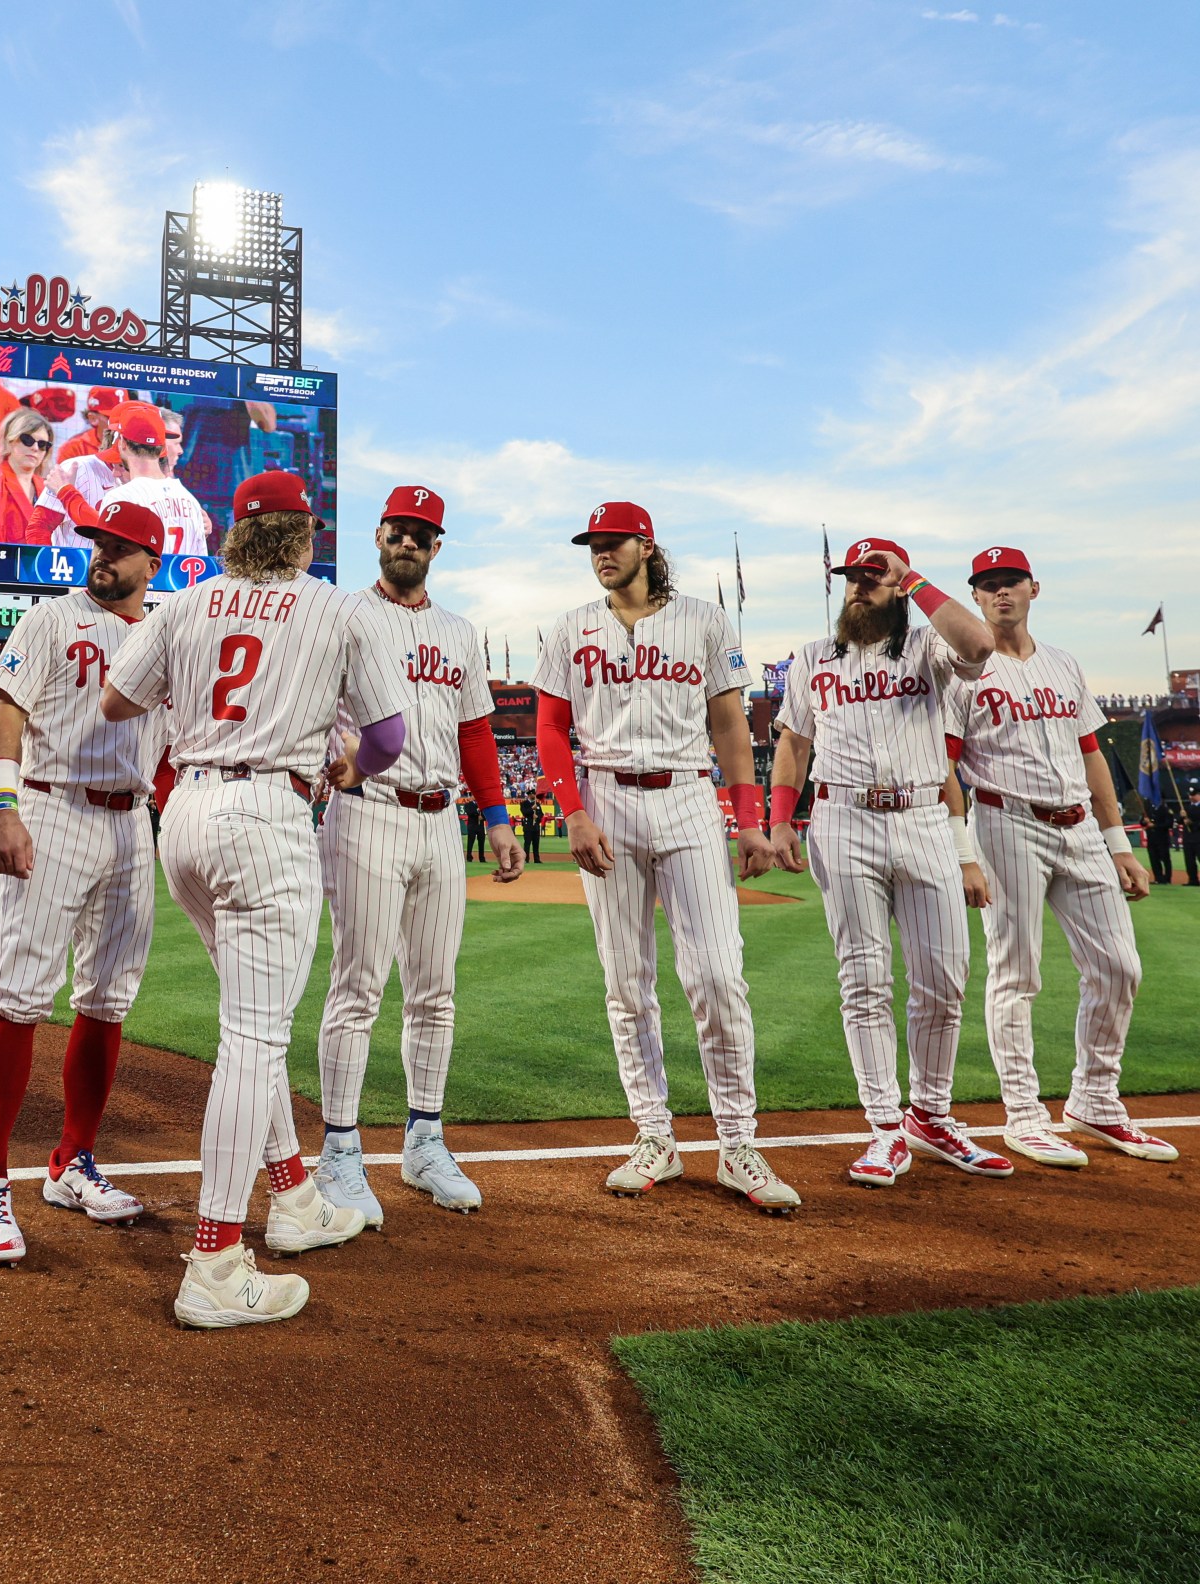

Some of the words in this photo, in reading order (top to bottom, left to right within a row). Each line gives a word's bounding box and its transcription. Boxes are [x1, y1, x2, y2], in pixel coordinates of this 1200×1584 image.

[75, 358, 103, 368] SALTZ
[107, 361, 167, 375] MONGELUZZI
[170, 367, 218, 379] BENDESKY
[103, 371, 140, 381] INJURY
[146, 375, 191, 386] LAWYERS
[263, 386, 316, 396] SPORTSBOOK
[413, 488, 430, 507] P
[104, 504, 121, 522] P
[593, 506, 606, 525] P
[167, 526, 185, 555] 7
[857, 541, 872, 559] P
[49, 548, 74, 582] LA
[987, 548, 1002, 564] P
[180, 557, 206, 588] P
[208, 589, 297, 624] BADER
[400, 643, 463, 691] illie
[572, 643, 704, 689] Phillies
[763, 671, 777, 680] ALL
[211, 633, 263, 723] 2
[810, 669, 931, 711] Phillies
[496, 696, 532, 707] GIANT
